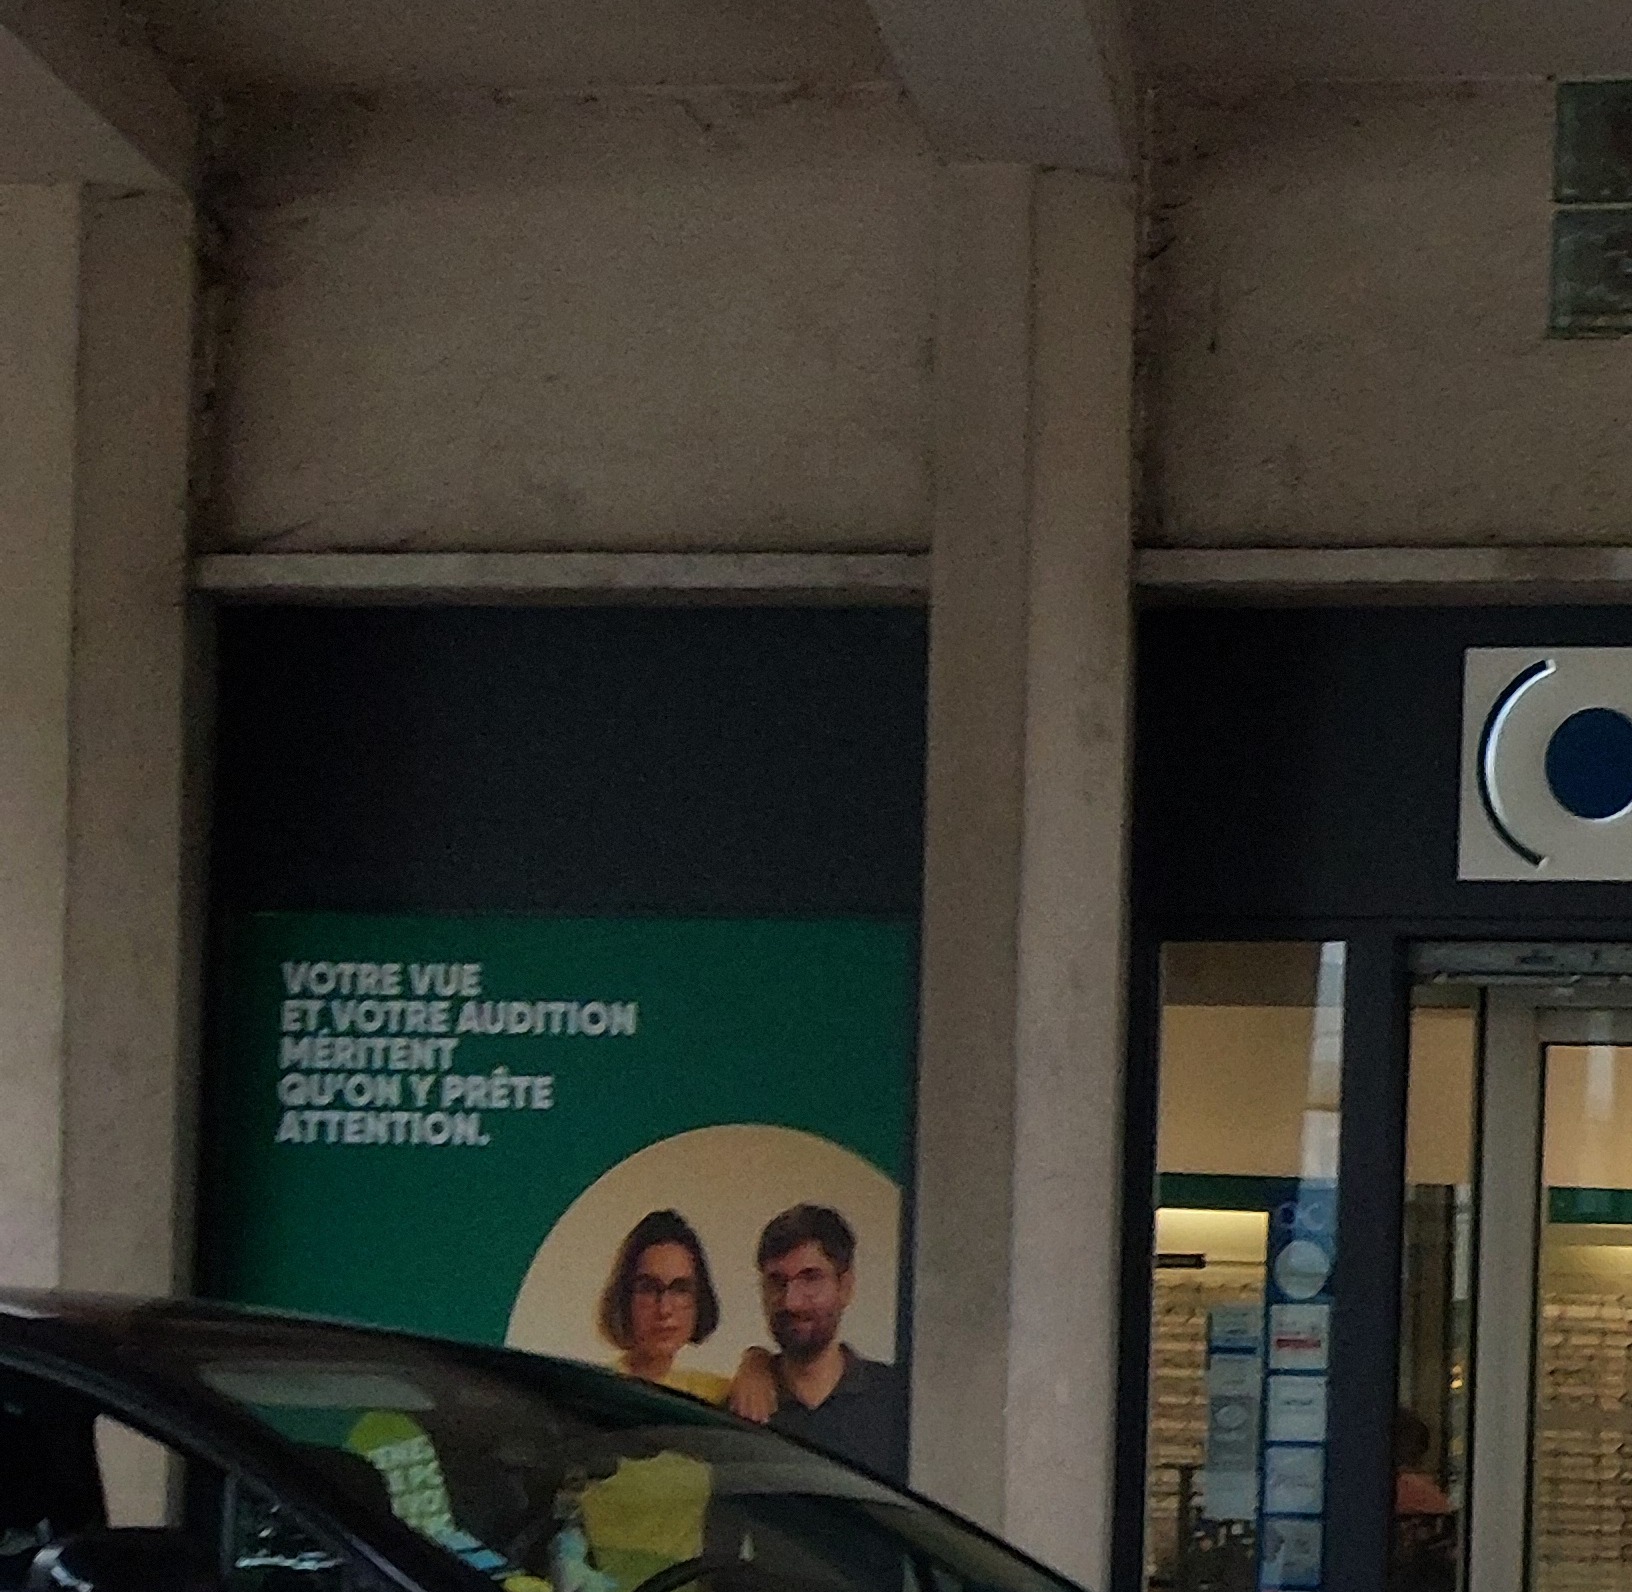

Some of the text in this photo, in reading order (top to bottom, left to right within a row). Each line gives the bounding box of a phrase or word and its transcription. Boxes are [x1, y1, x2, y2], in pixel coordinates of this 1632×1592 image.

[280, 962, 482, 996] VOTRE VUE
[282, 1000, 638, 1036] ET VOTRE AUDITION
[280, 1028, 458, 1070] MÉRITENT
[277, 1066, 554, 1110] QU'ON Y PRÊTE
[275, 1111, 491, 1146] ATTENTION.
